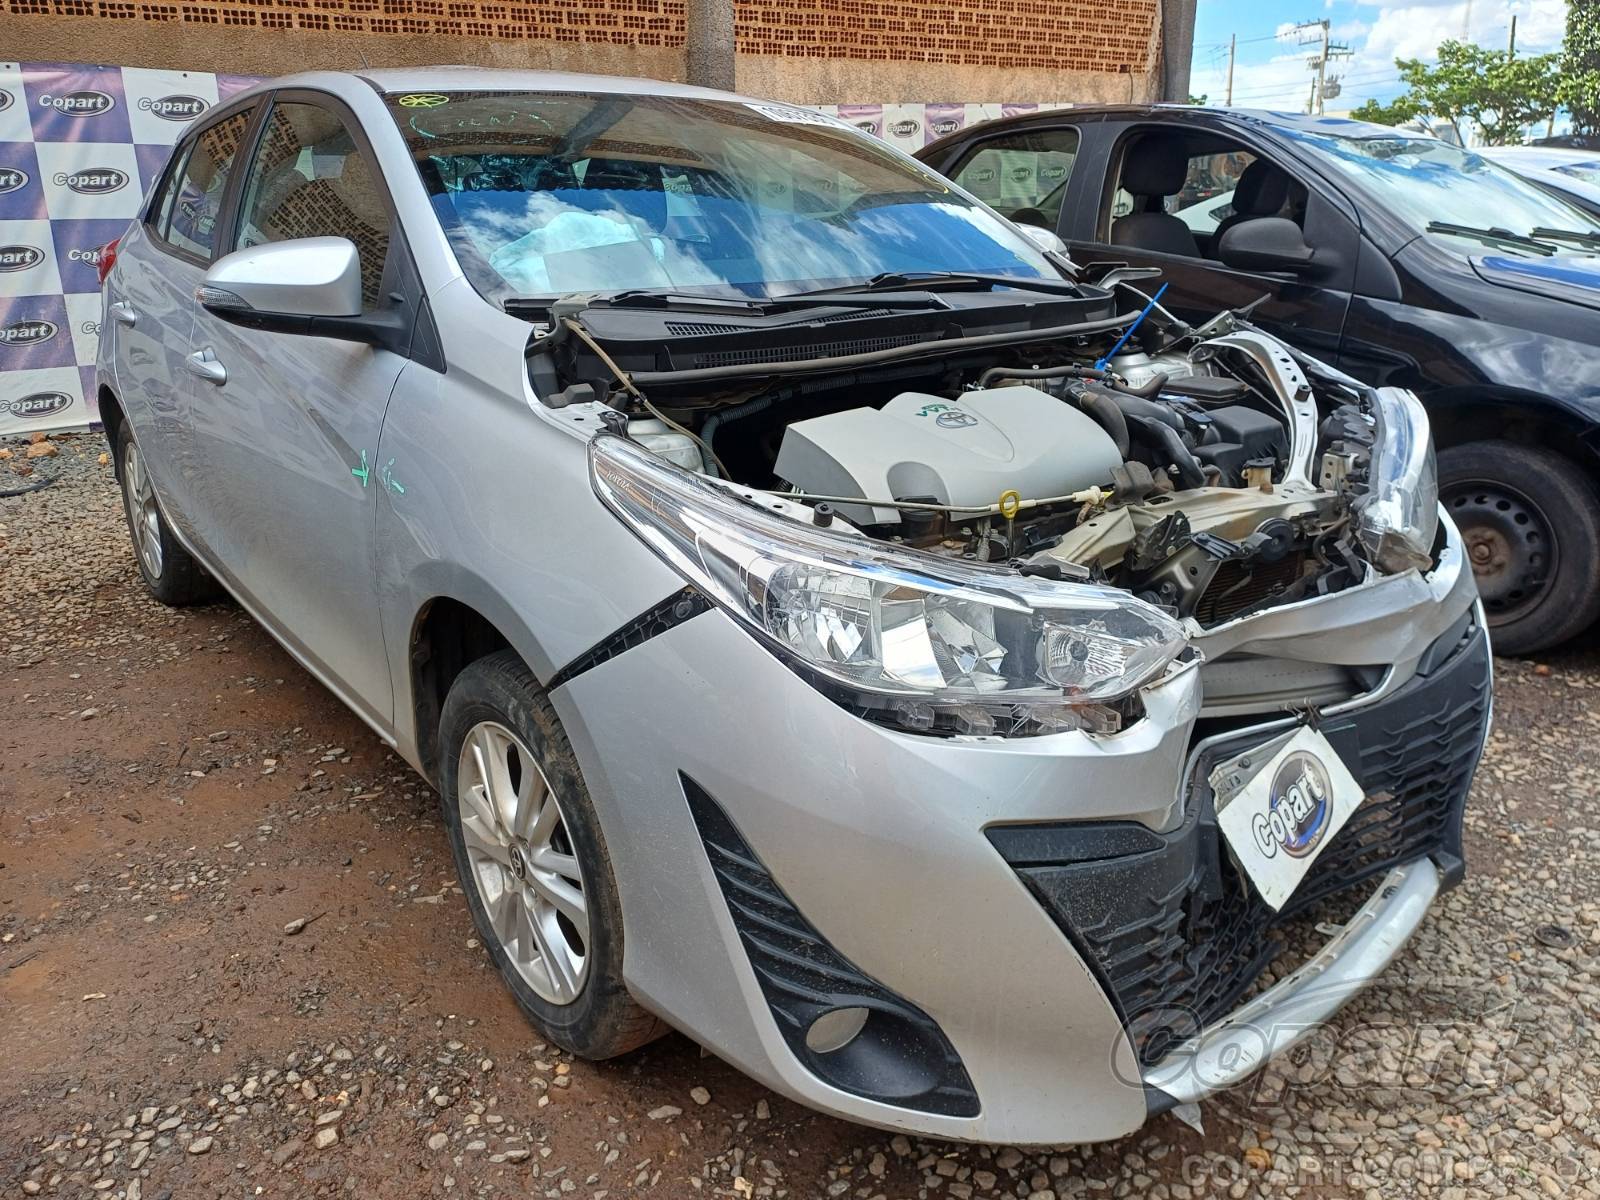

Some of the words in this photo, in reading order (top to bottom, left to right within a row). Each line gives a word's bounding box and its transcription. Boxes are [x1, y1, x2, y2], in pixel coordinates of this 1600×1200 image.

[38, 94, 104, 110] Copart
[138, 97, 201, 114] Copart
[887, 122, 915, 135] Copart
[929, 121, 957, 133] Copart
[53, 171, 118, 188] Copart
[0, 395, 63, 414] Copart
[606, 470, 632, 491] TOYOTA
[1251, 759, 1326, 859] Copart
